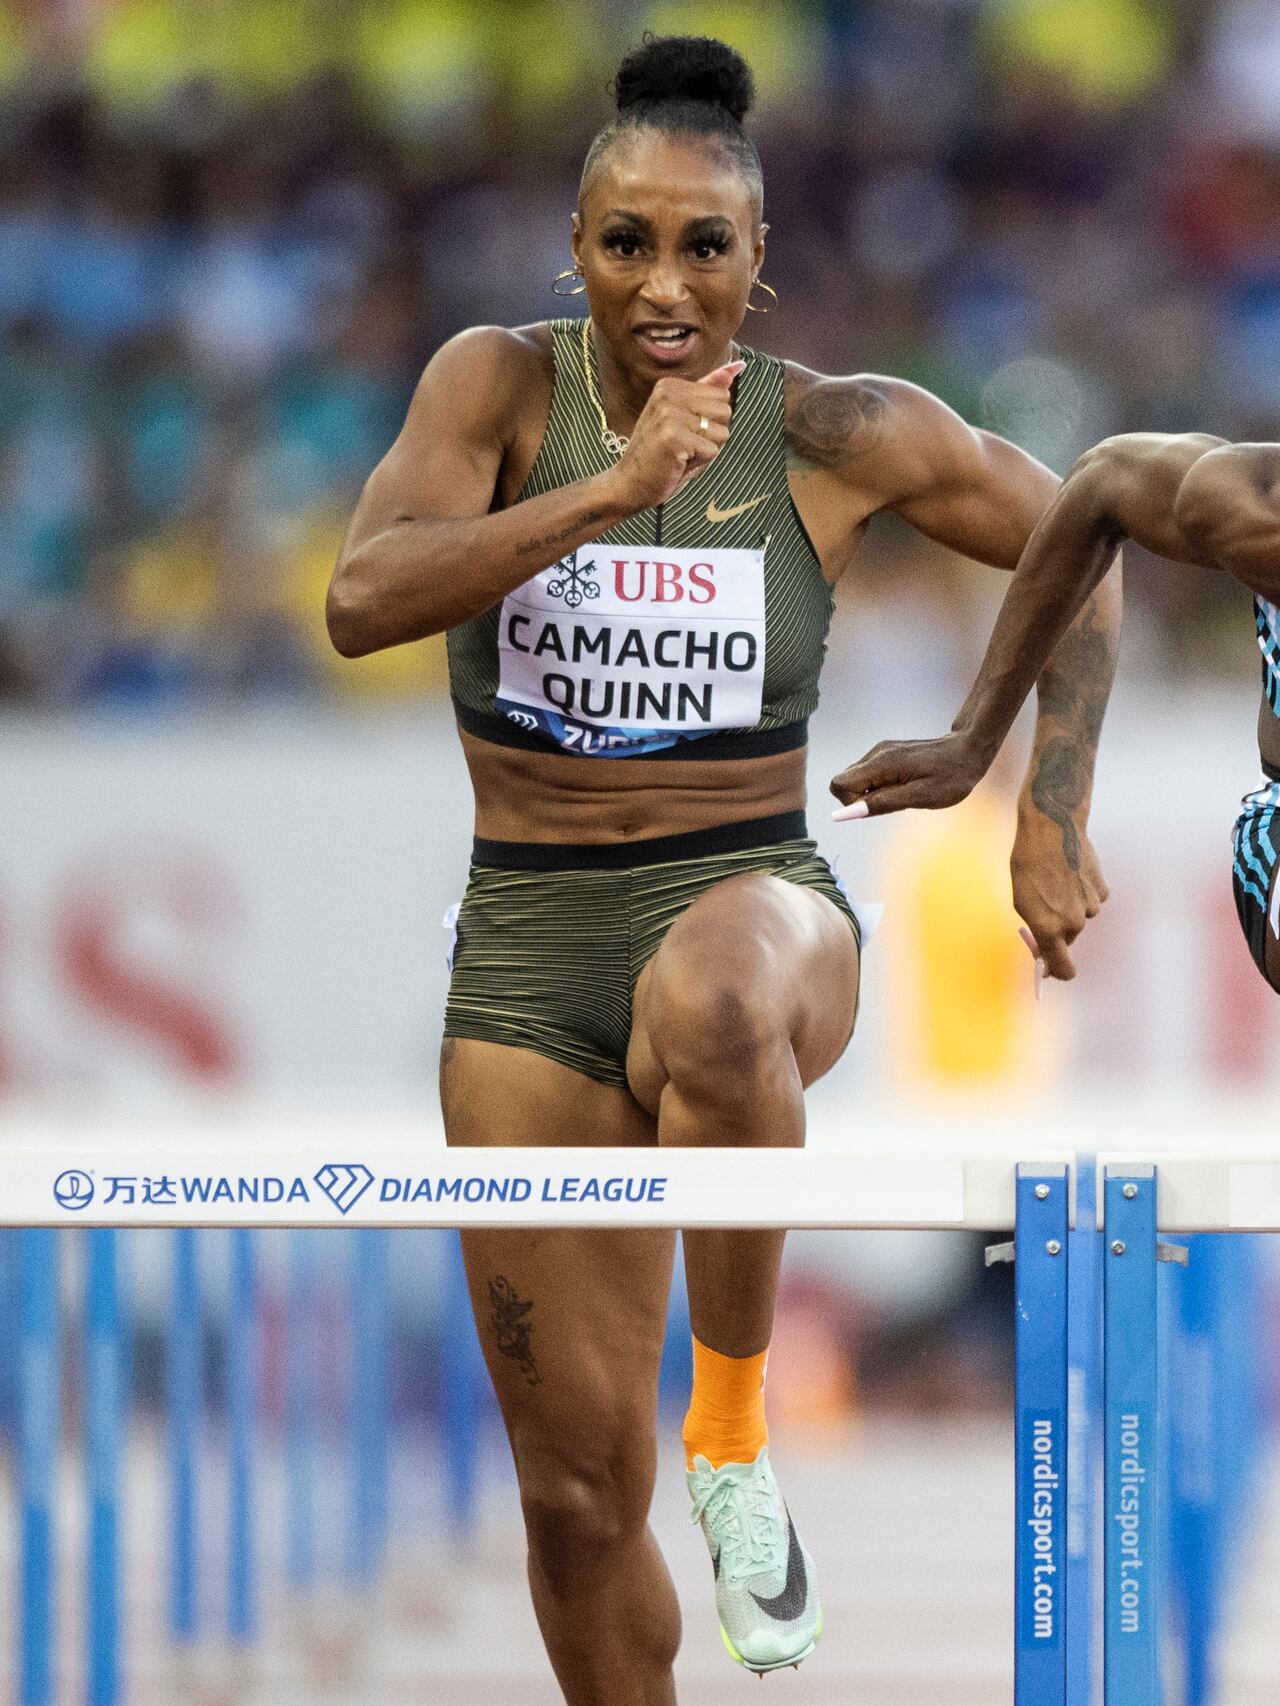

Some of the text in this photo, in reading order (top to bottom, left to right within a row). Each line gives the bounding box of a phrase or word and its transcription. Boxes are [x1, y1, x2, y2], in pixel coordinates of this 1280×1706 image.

[611, 559, 717, 604] UBS
[507, 614, 758, 673] CAMACHO
[542, 672, 714, 723] QUINN
[103, 1175, 668, 1205] 万达 WANDA DIAMOND LEAGUE
[1027, 1419, 1059, 1639] nordicsport.com
[1115, 1413, 1147, 1634] nordicsport.com
